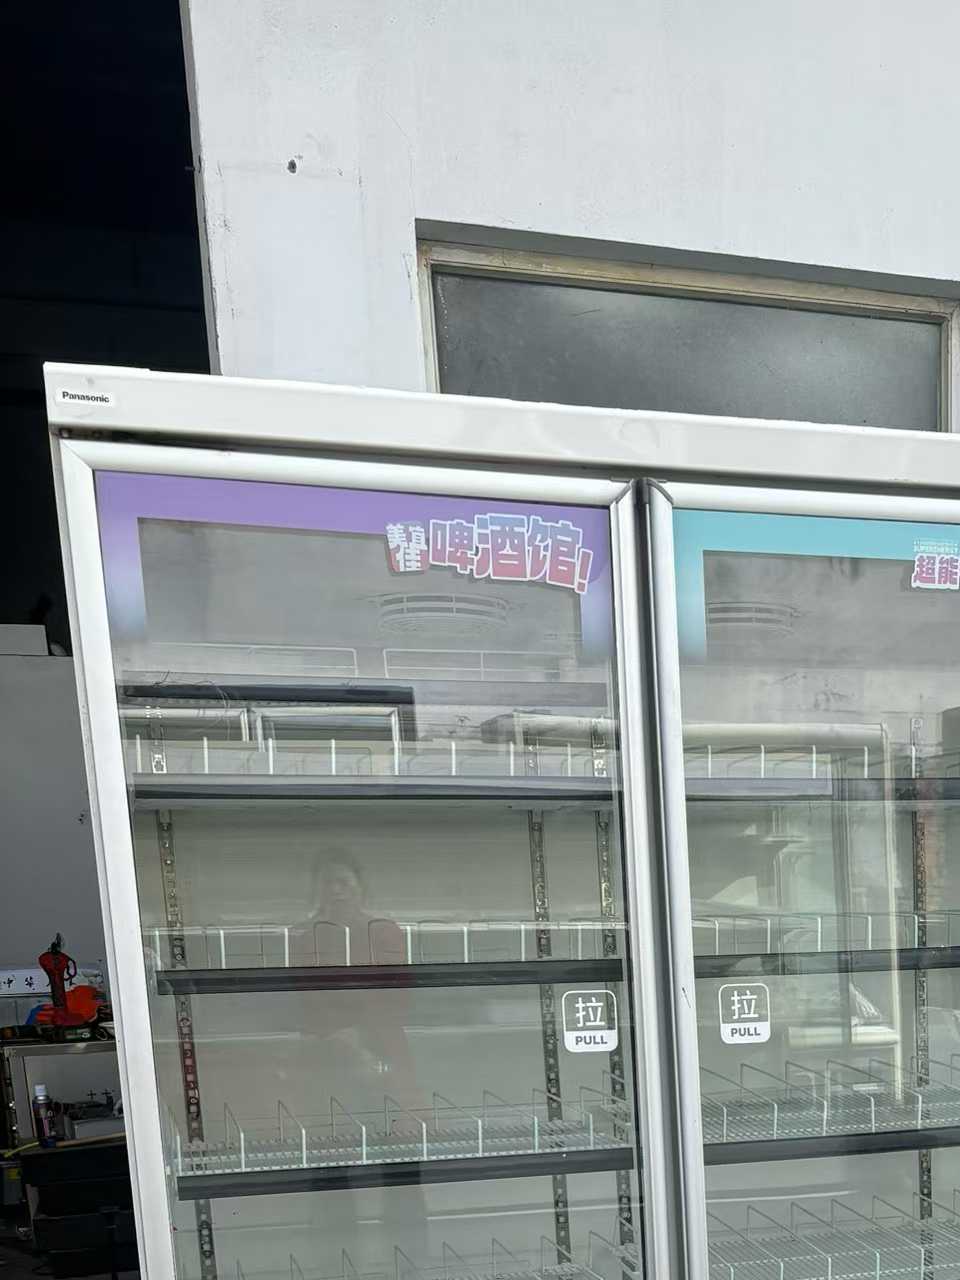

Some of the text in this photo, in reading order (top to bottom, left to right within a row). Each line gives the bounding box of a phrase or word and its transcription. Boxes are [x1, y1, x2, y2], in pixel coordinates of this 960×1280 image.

[62, 391, 110, 403] Panasonic
[731, 990, 760, 1019] 拉
[575, 997, 606, 1028] 拉
[730, 1026, 761, 1037] PULL
[575, 1034, 608, 1046] PULL
